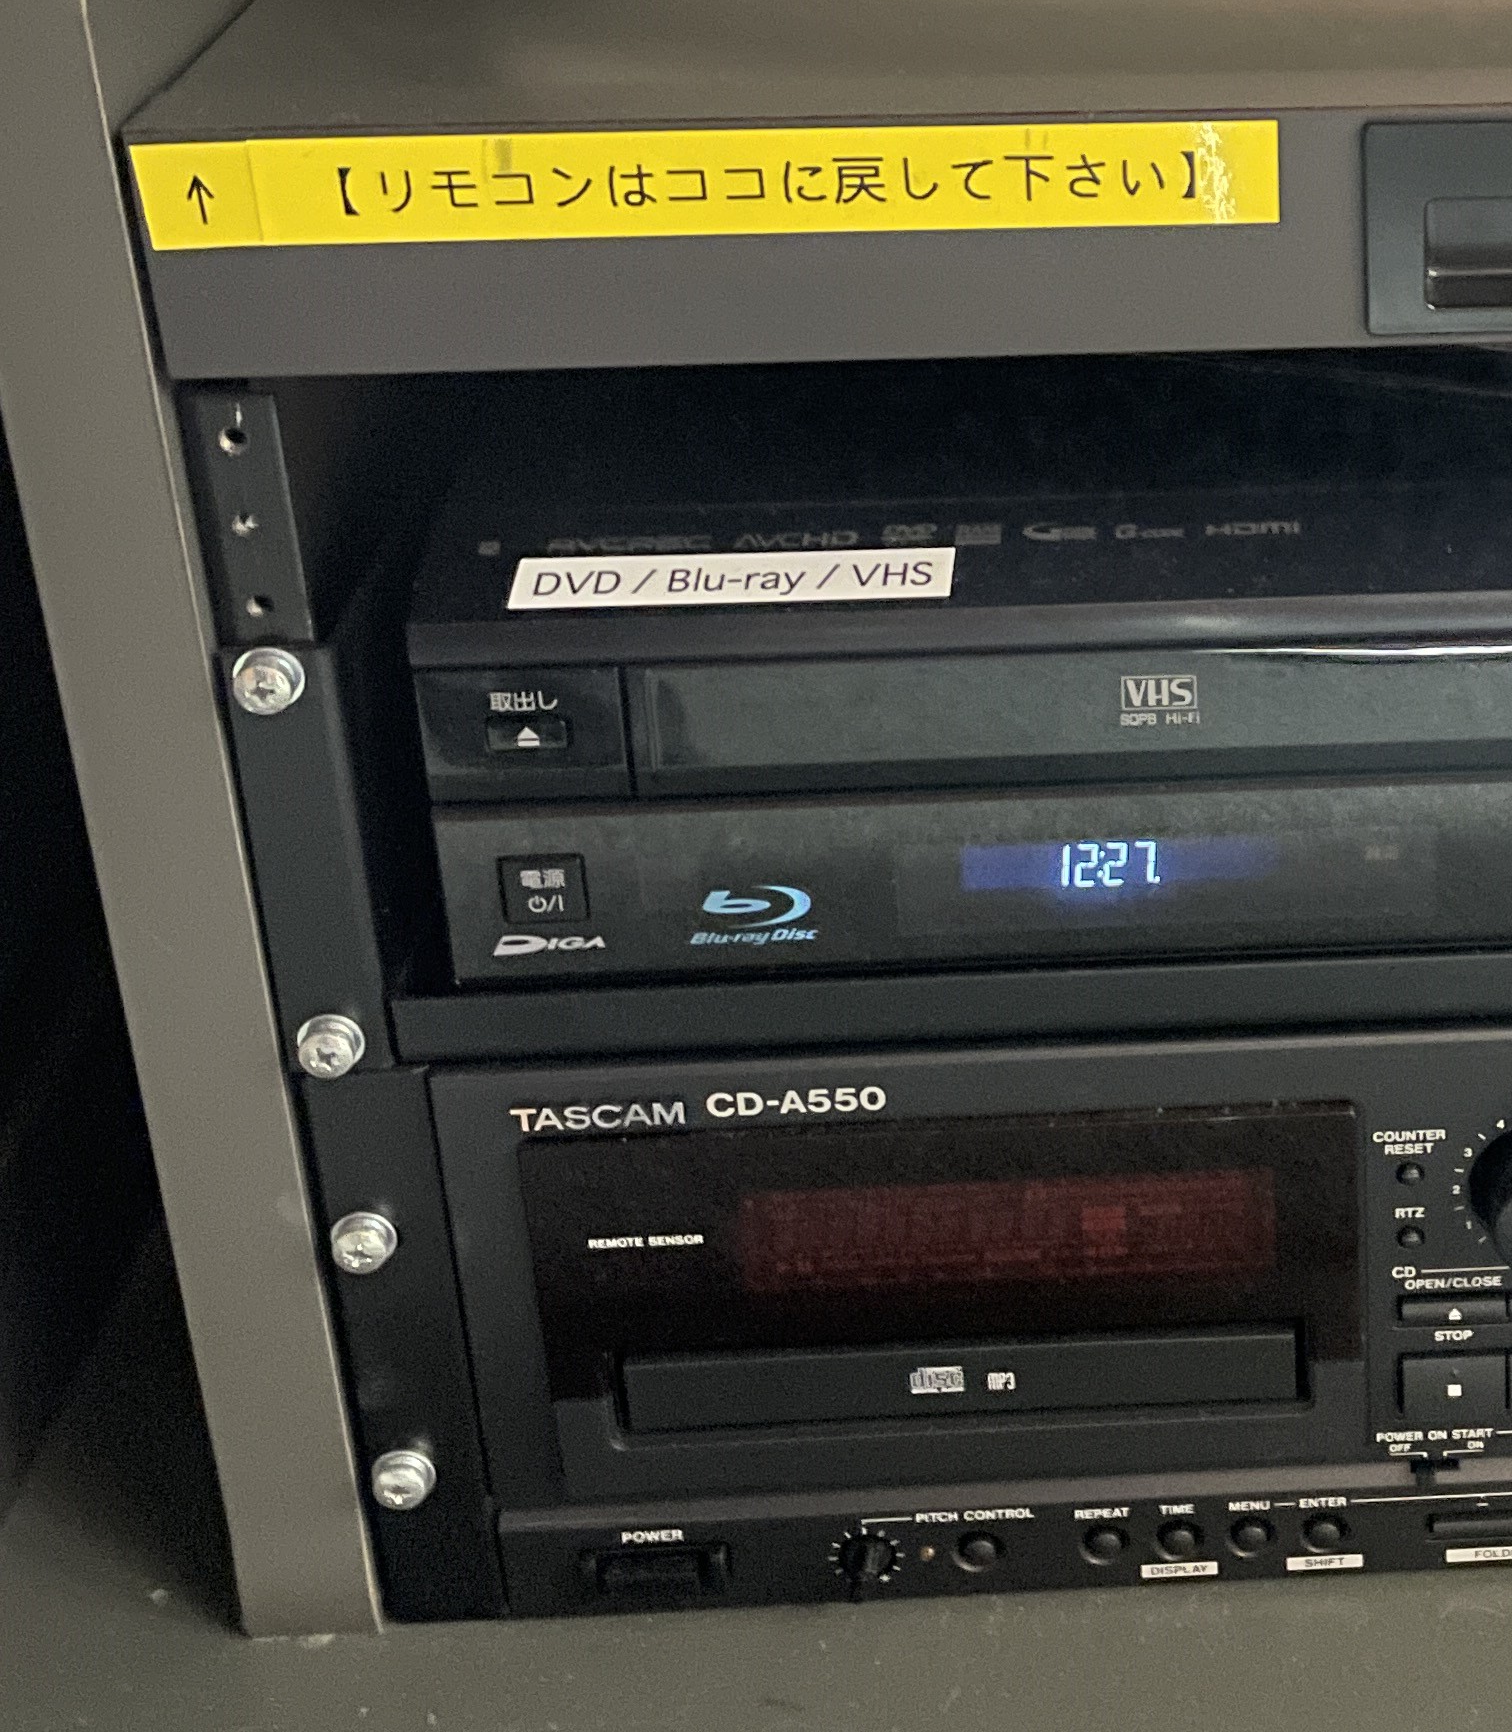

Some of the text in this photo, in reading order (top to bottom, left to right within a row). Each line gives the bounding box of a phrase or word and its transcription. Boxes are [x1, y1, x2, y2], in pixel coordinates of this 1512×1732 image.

[334, 148, 1202, 218] 【リモコンはココに戻して下さい】
[533, 561, 933, 596] DVD / Blu-ray / VHS
[1126, 678, 1193, 707] VHS
[489, 690, 558, 711] 取出し
[1059, 840, 1162, 888] 12:27
[519, 867, 567, 891] 電源
[690, 927, 819, 945] Blu-ray Disc
[493, 933, 606, 957] DIGA
[509, 1085, 887, 1133] TASCAM CD-A550
[1496, 1118, 1506, 1129] 4
[1372, 1129, 1447, 1143] COUNTER
[1384, 1142, 1435, 1156] RESET
[1463, 1147, 1473, 1157] 3
[1451, 1184, 1461, 1195] 2
[1394, 1207, 1426, 1219] RTZ
[587, 1233, 704, 1250] REMOTE SENSOR
[1391, 1266, 1417, 1279] CD
[1404, 1276, 1503, 1291] OPEN/CLOSE
[1434, 1329, 1475, 1342] STOP
[1376, 1427, 1494, 1443] POWER ON START
[1389, 1442, 1411, 1452] OFF
[1158, 1503, 1195, 1516] TIME
[1227, 1500, 1271, 1512] MENU
[1298, 1496, 1348, 1510] ENTER
[915, 1508, 1035, 1524] PITCH CONTROL
[1073, 1506, 1130, 1520] REPEAT
[621, 1529, 685, 1545] POWER
[1149, 1562, 1211, 1577] DISPLAY
[1303, 1555, 1346, 1569] SHIFT
